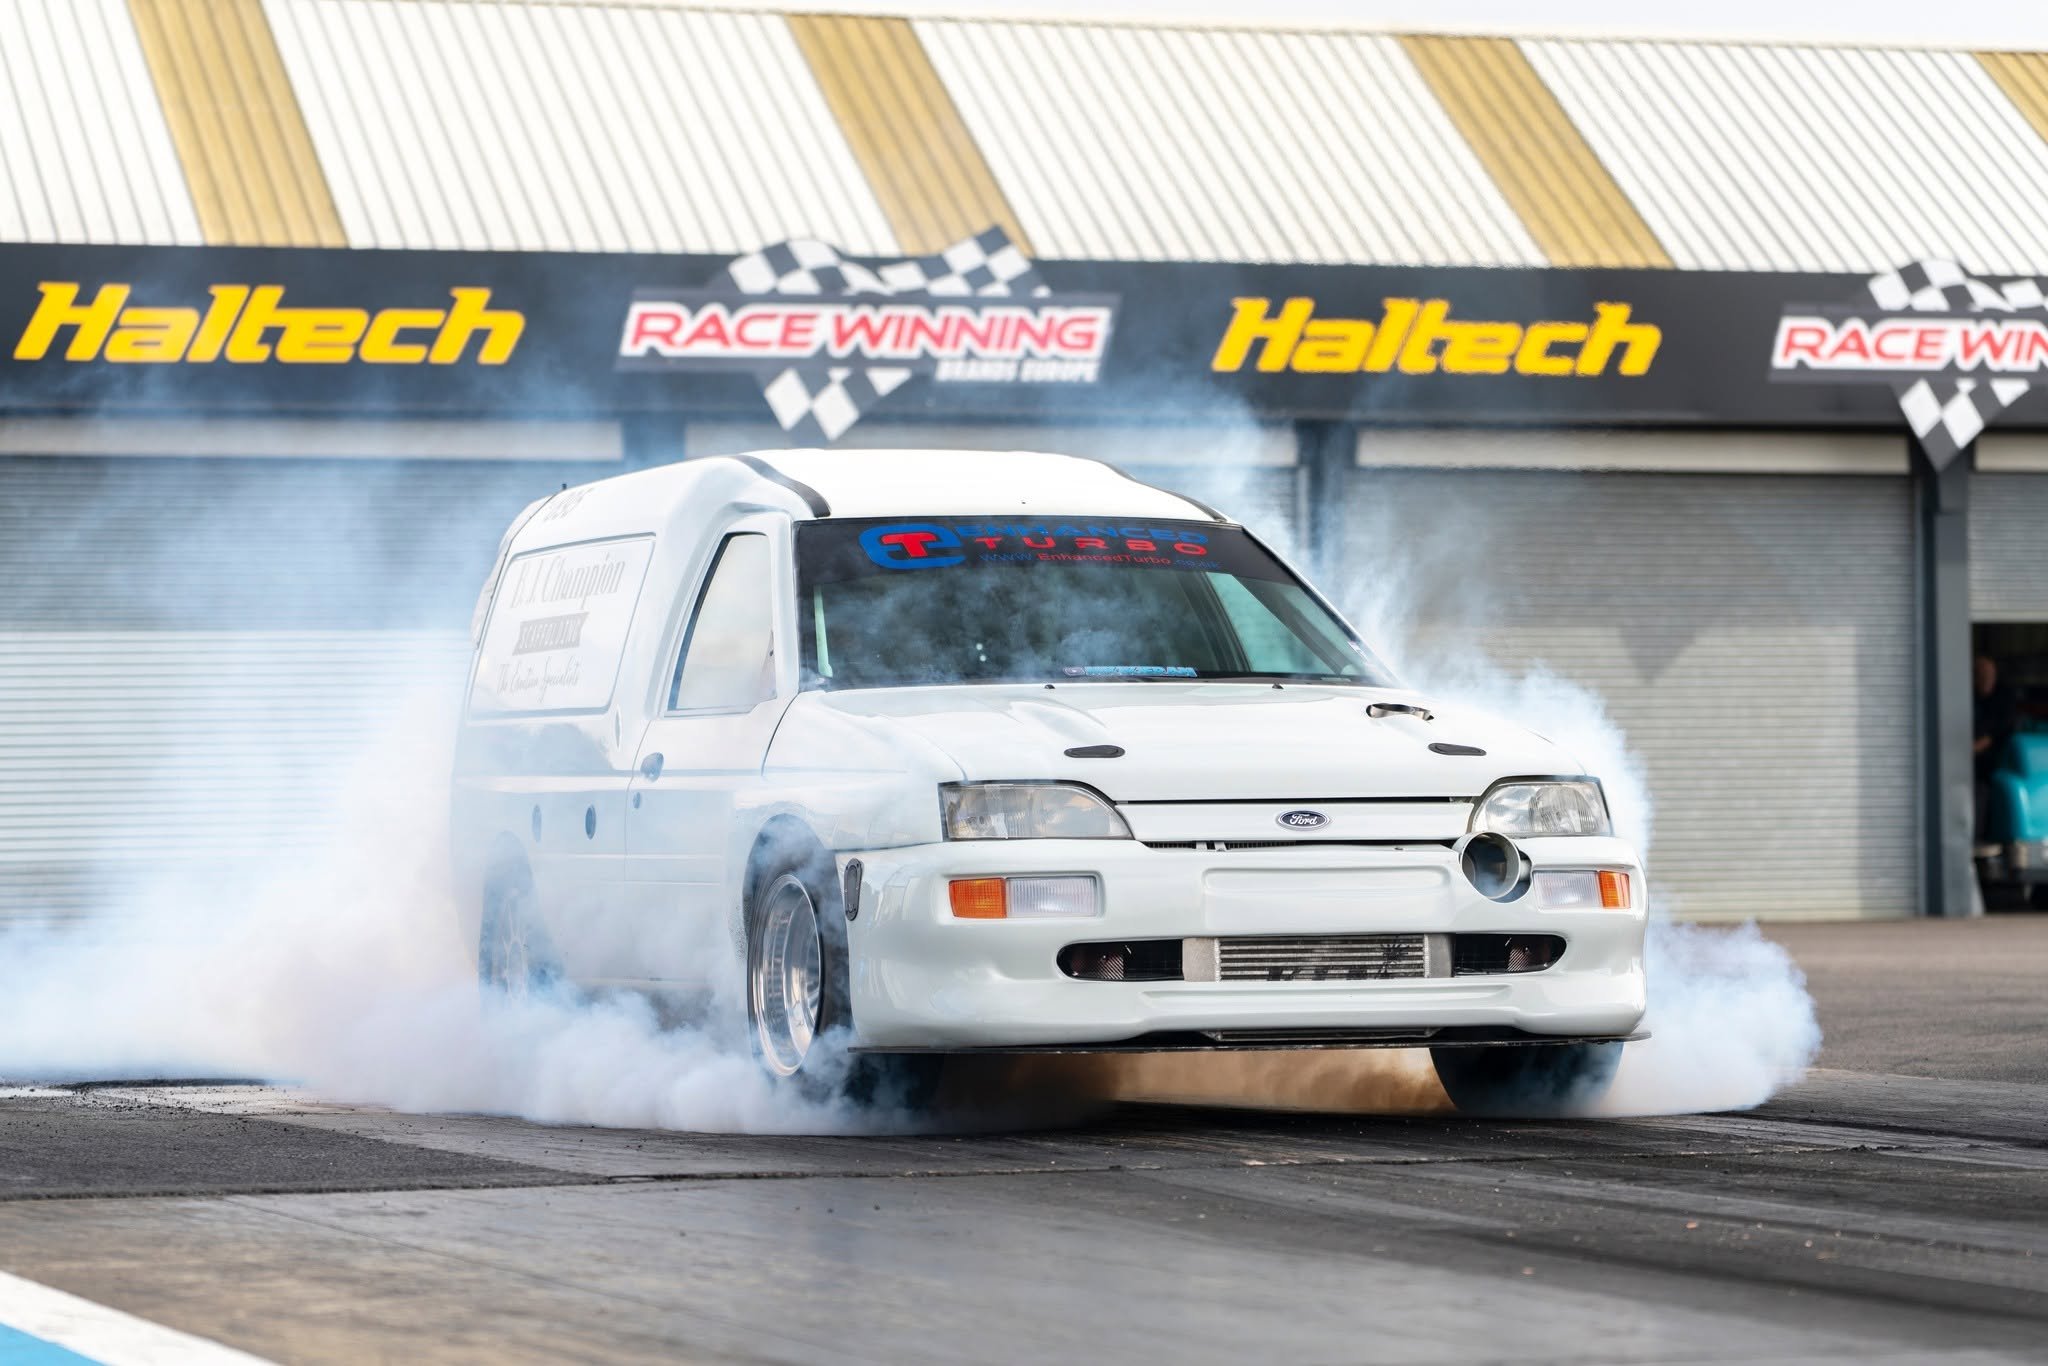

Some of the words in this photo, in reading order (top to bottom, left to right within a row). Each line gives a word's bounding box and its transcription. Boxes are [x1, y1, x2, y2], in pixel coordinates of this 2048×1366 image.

[13, 281, 525, 365] Haltech
[627, 310, 824, 350] RACE
[832, 312, 1103, 352] WINNING
[1210, 297, 1663, 377] Haltech
[1780, 325, 1951, 362] RACE
[955, 525, 1208, 544] ENHANCED
[975, 536, 1207, 556] TURBO
[1289, 813, 1318, 825] Ford
